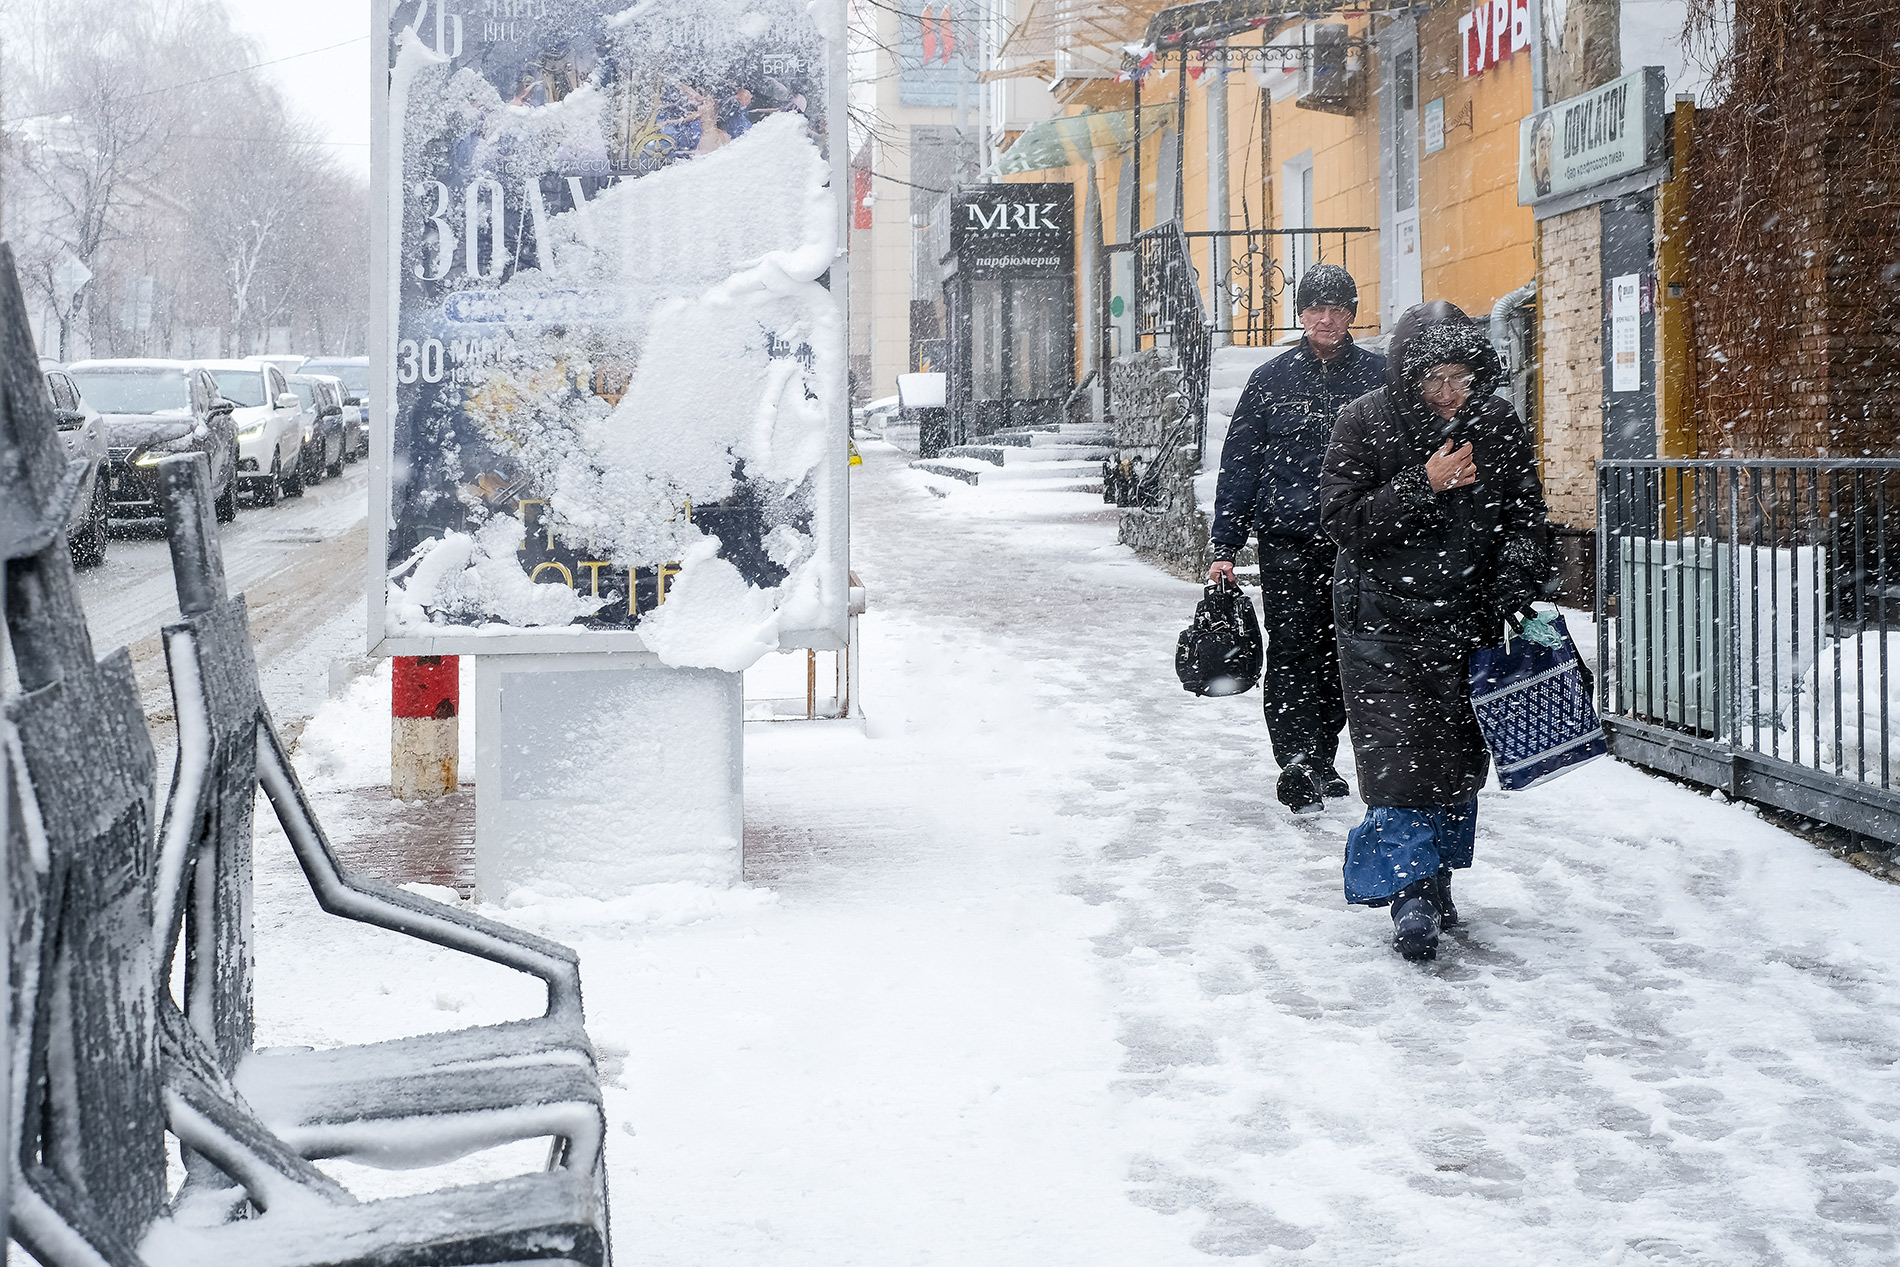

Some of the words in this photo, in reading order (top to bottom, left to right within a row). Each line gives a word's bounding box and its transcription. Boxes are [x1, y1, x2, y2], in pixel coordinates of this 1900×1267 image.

[965, 203, 1060, 230] MRK
[976, 254, 1061, 269] парфюмерия
[398, 338, 444, 384] 30
